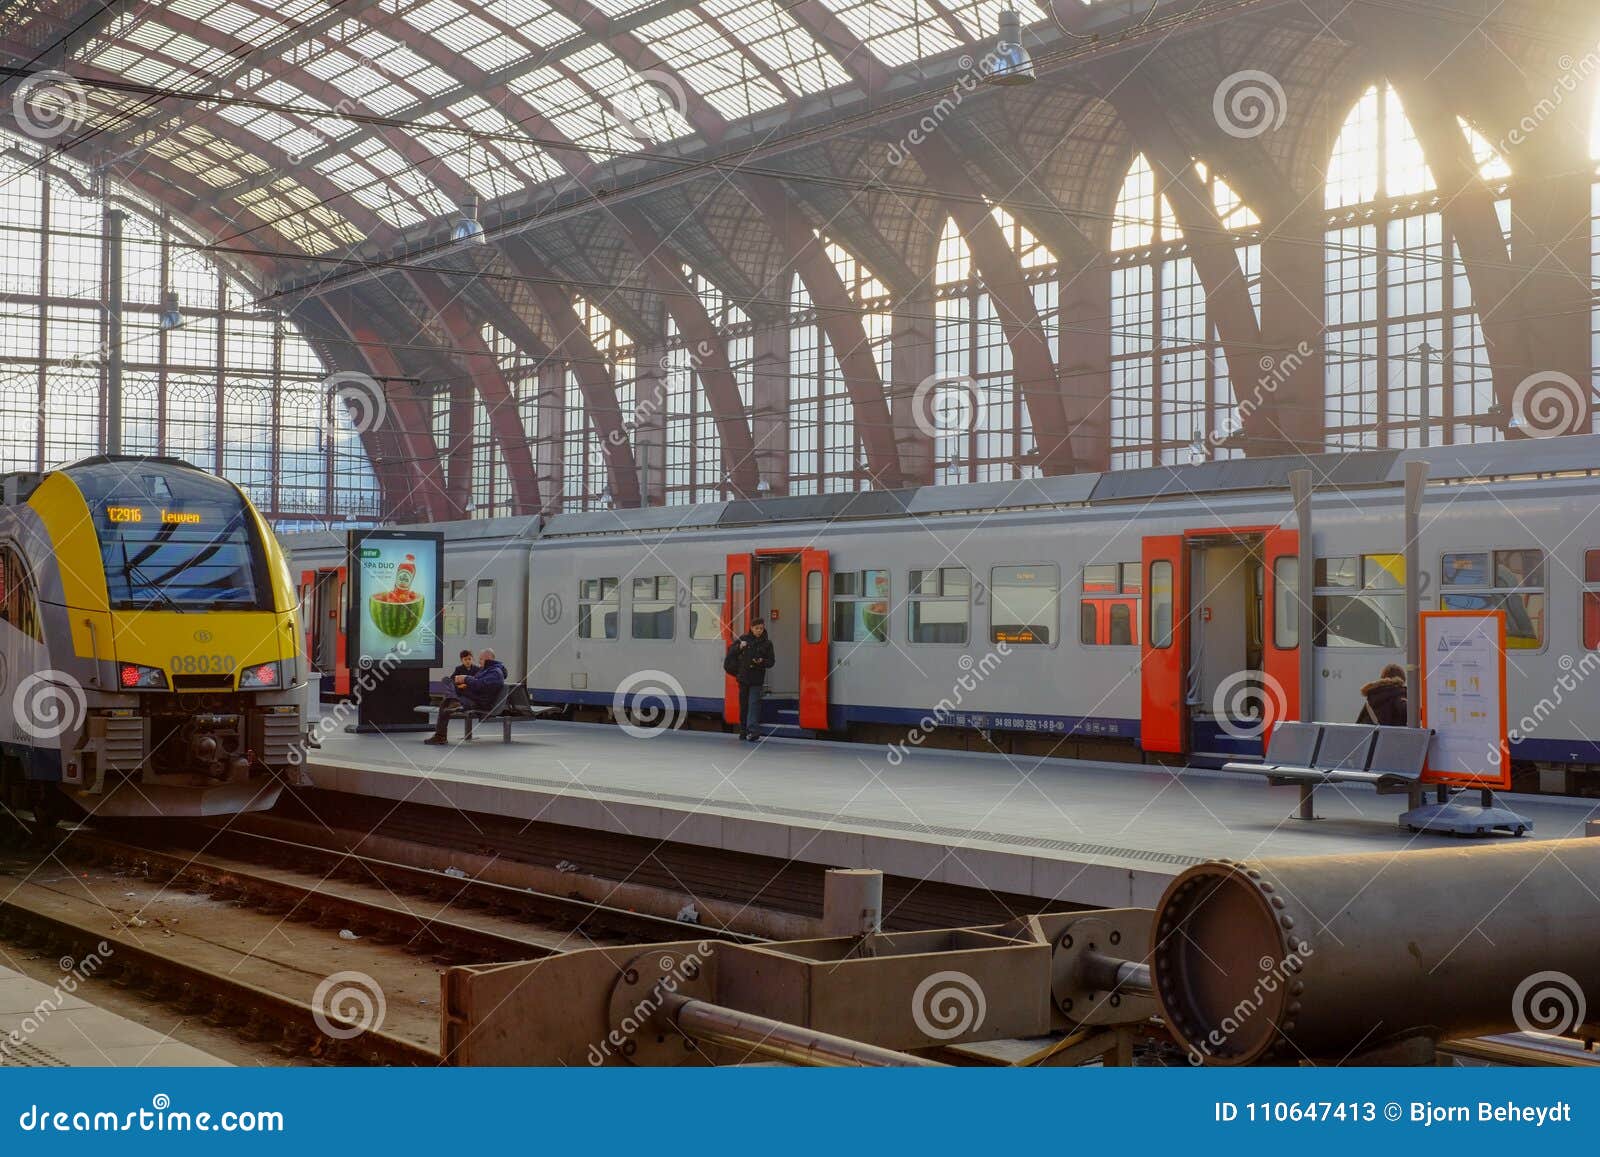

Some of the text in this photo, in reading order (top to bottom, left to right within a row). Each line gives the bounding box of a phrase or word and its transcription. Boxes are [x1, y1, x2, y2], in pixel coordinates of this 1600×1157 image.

[161, 509, 200, 524] Leuven
[363, 561, 395, 570] SPA DUO
[974, 581, 985, 606] 2
[1418, 570, 1432, 601] 2
[679, 588, 687, 608] 2
[170, 655, 236, 673] 08030
